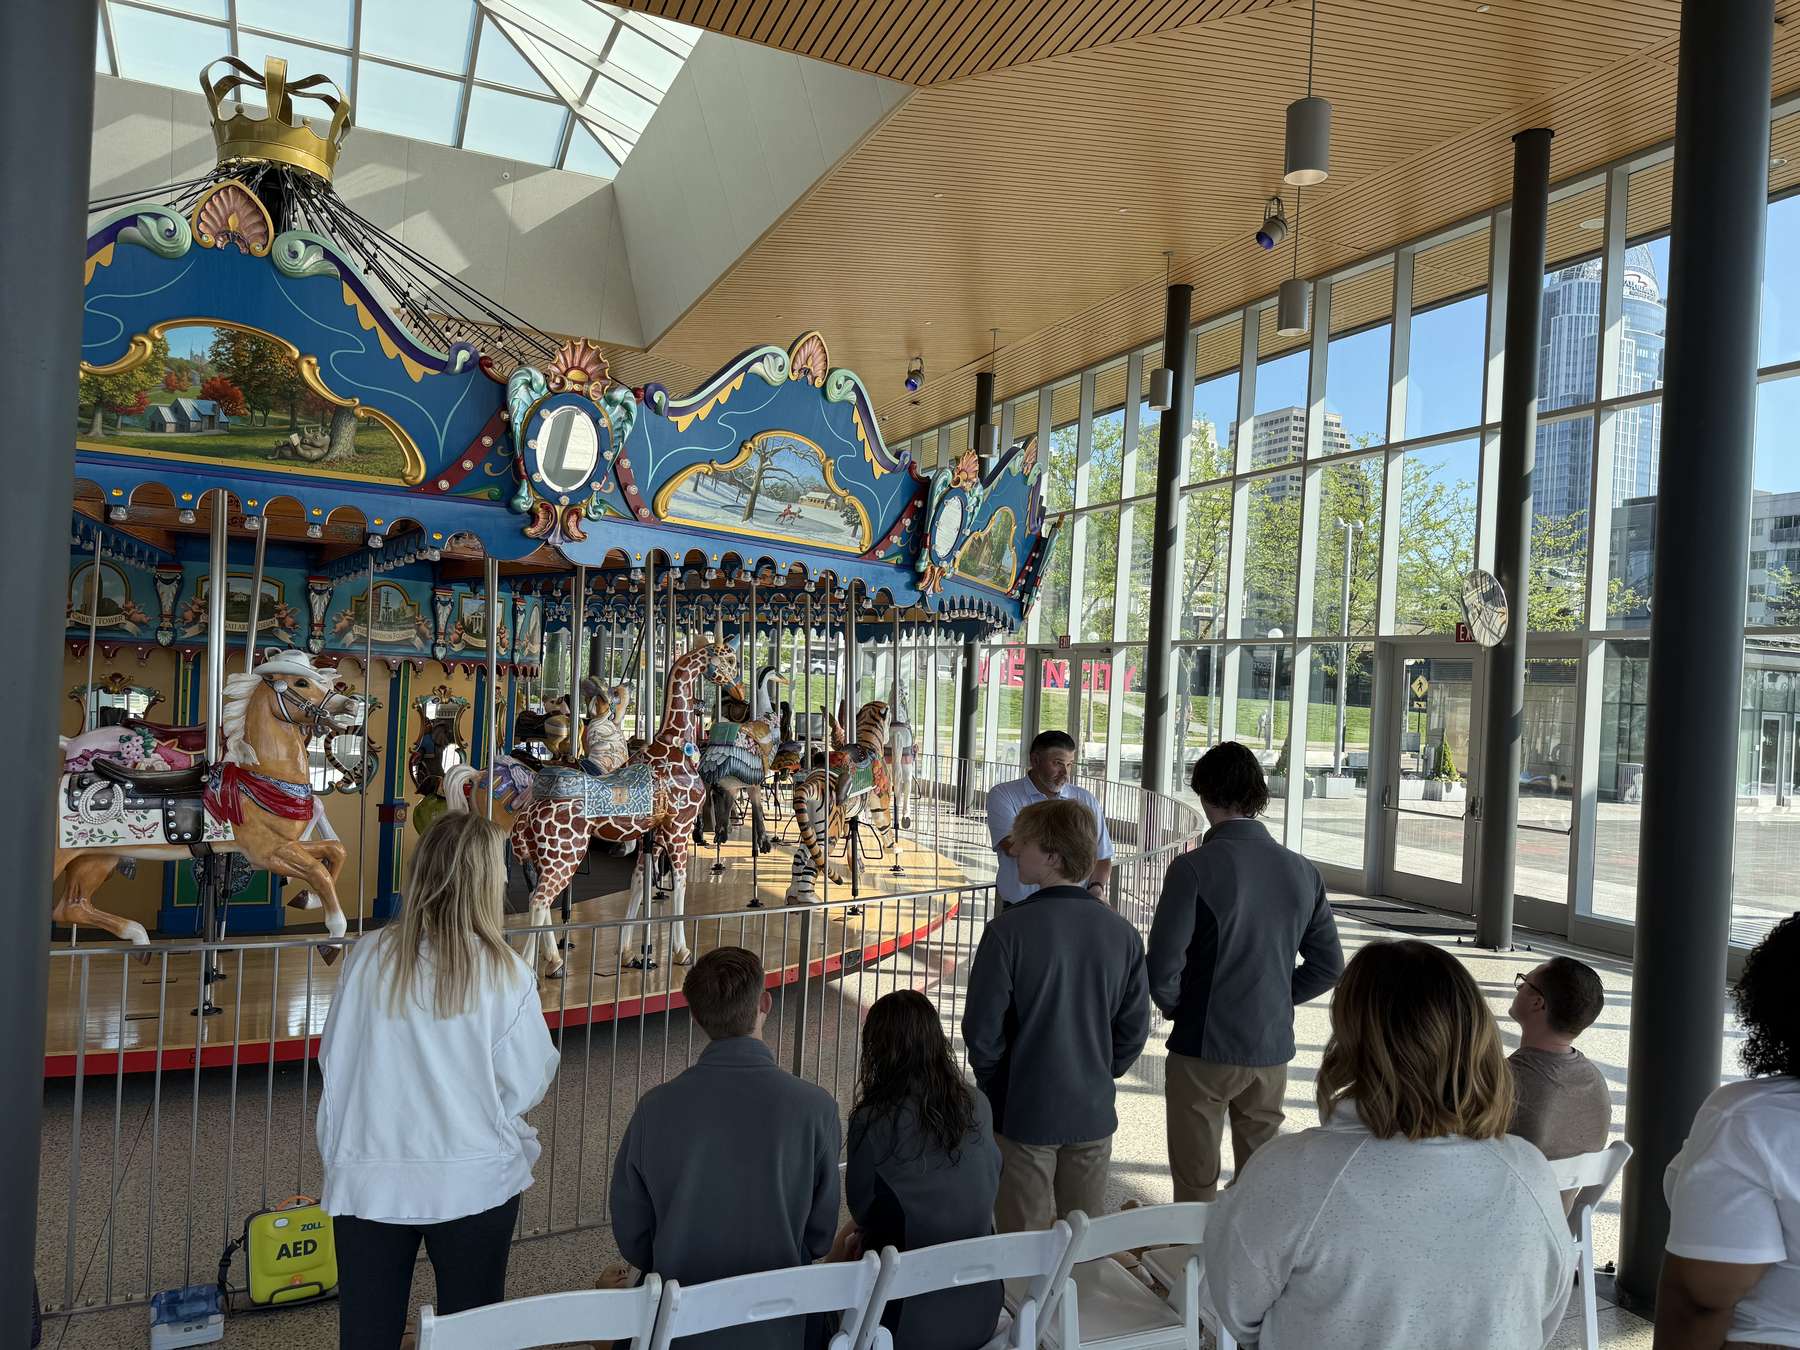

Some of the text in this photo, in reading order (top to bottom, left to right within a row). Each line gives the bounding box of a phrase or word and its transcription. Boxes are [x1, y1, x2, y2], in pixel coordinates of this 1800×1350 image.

[98, 615, 123, 625] TOWER
[1459, 624, 1471, 641] EX
[1060, 636, 1070, 648] EXIT
[300, 1221, 326, 1231] ZOLL
[276, 1238, 318, 1260] AED
